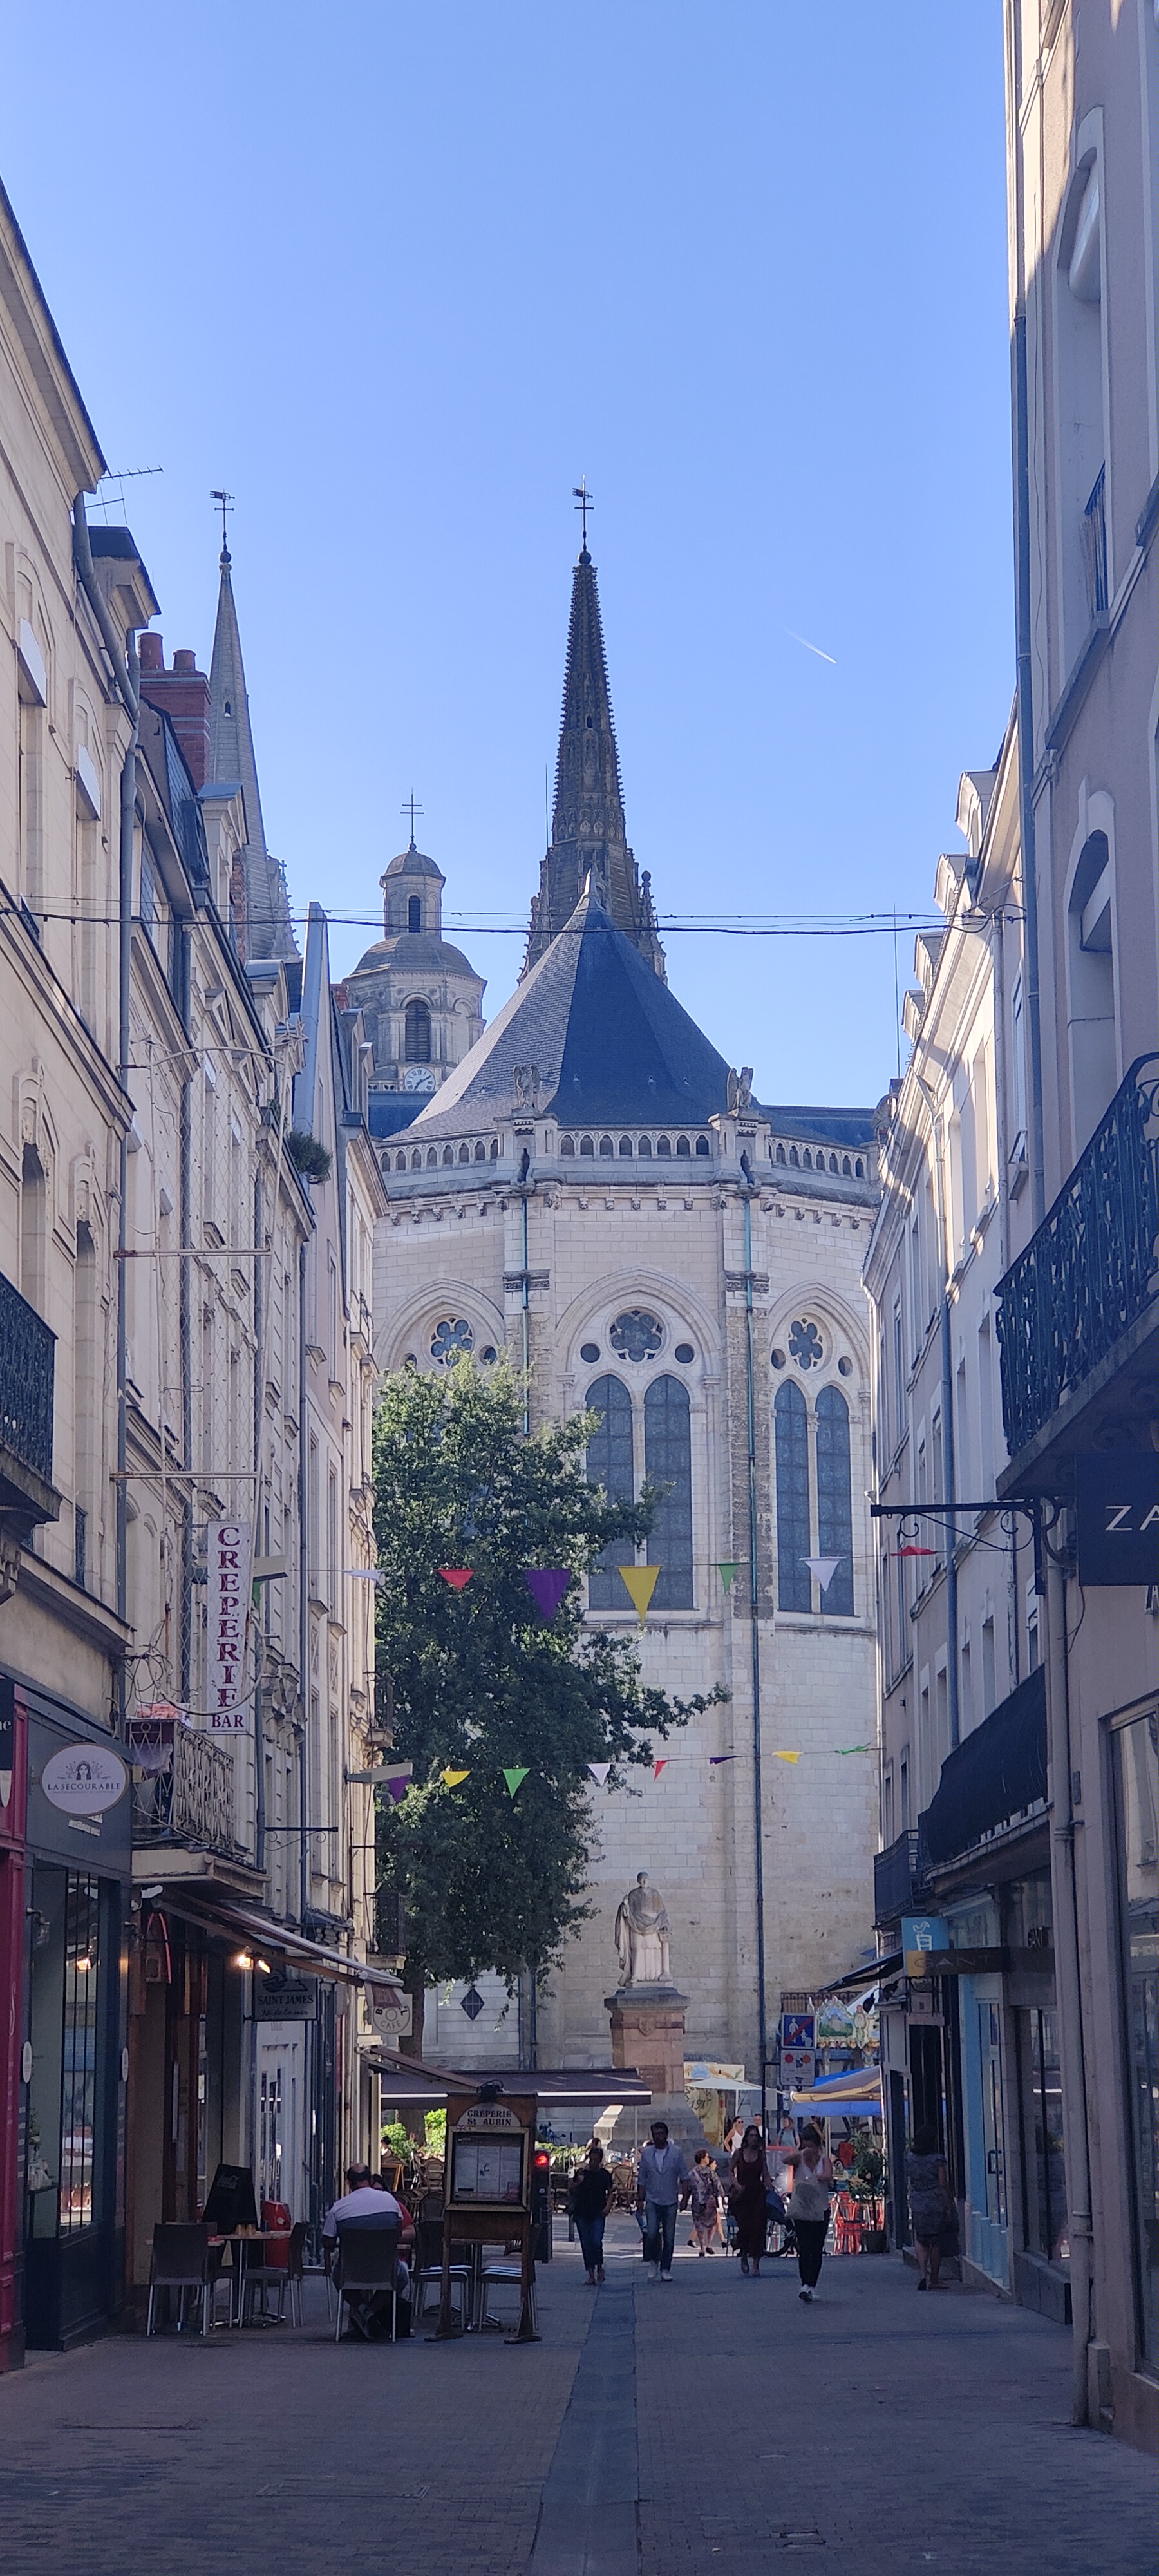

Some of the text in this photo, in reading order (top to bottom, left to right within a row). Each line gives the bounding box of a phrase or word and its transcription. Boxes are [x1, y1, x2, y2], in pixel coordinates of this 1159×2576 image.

[217, 1526, 241, 1707] CREPERIE
[211, 1714, 245, 1728] BAR
[914, 1955, 994, 1969] GANT
[258, 1995, 314, 2005] SAINT JAMES
